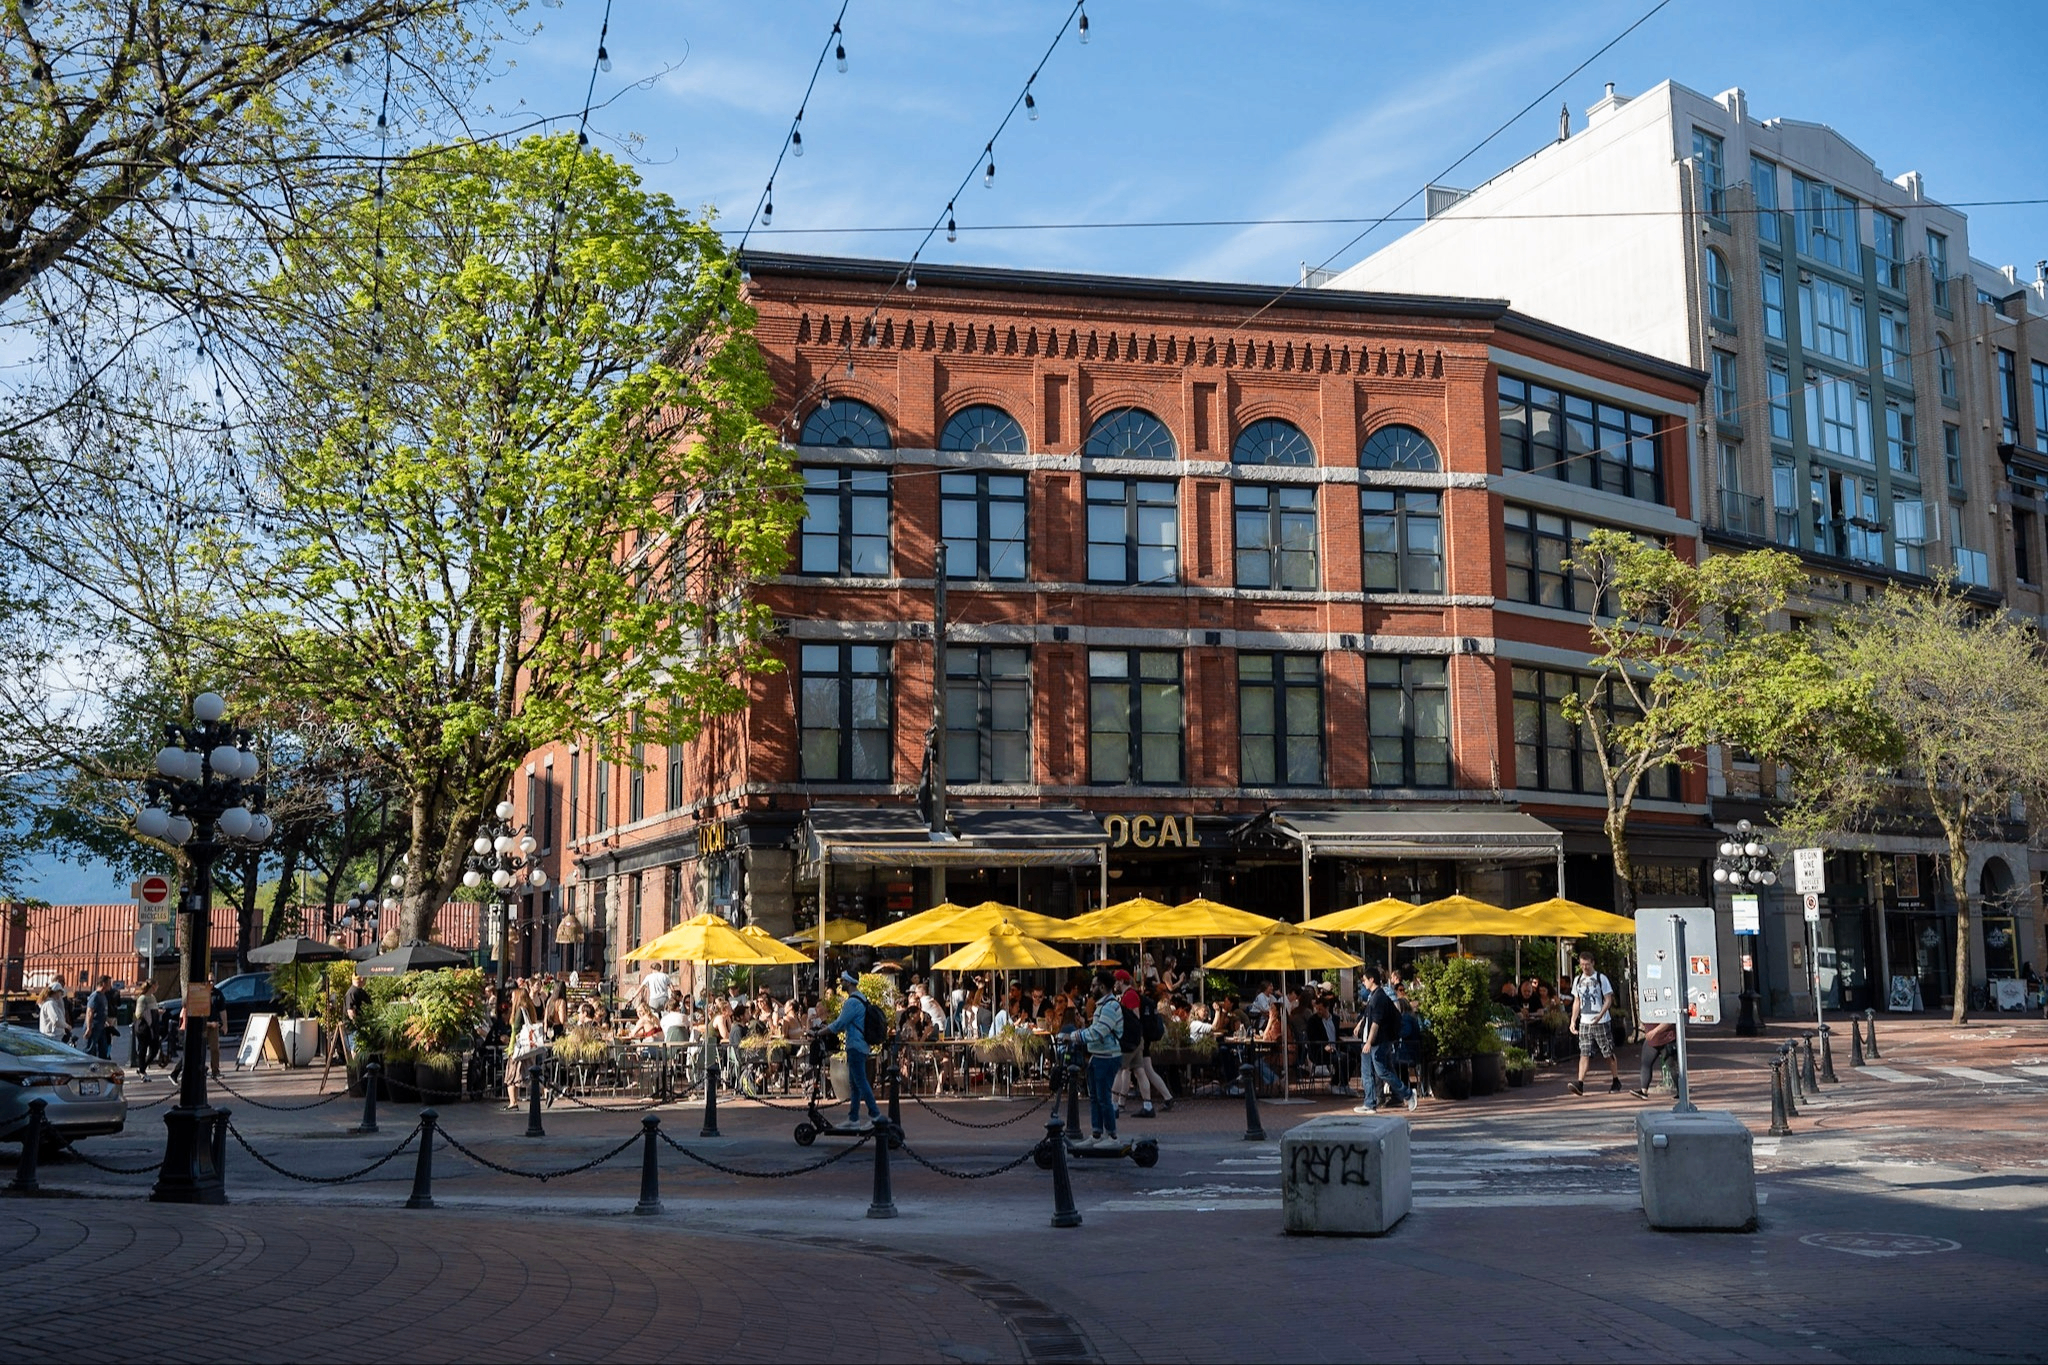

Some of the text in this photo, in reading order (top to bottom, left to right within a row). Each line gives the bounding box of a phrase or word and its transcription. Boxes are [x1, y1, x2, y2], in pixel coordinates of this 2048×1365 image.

[1103, 815, 1201, 848] OCAL
[699, 821, 726, 854] LOCAL
[1800, 851, 1818, 860] BEGIN
[1803, 860, 1815, 869] ONE
[140, 912, 167, 920] BICYCLES
